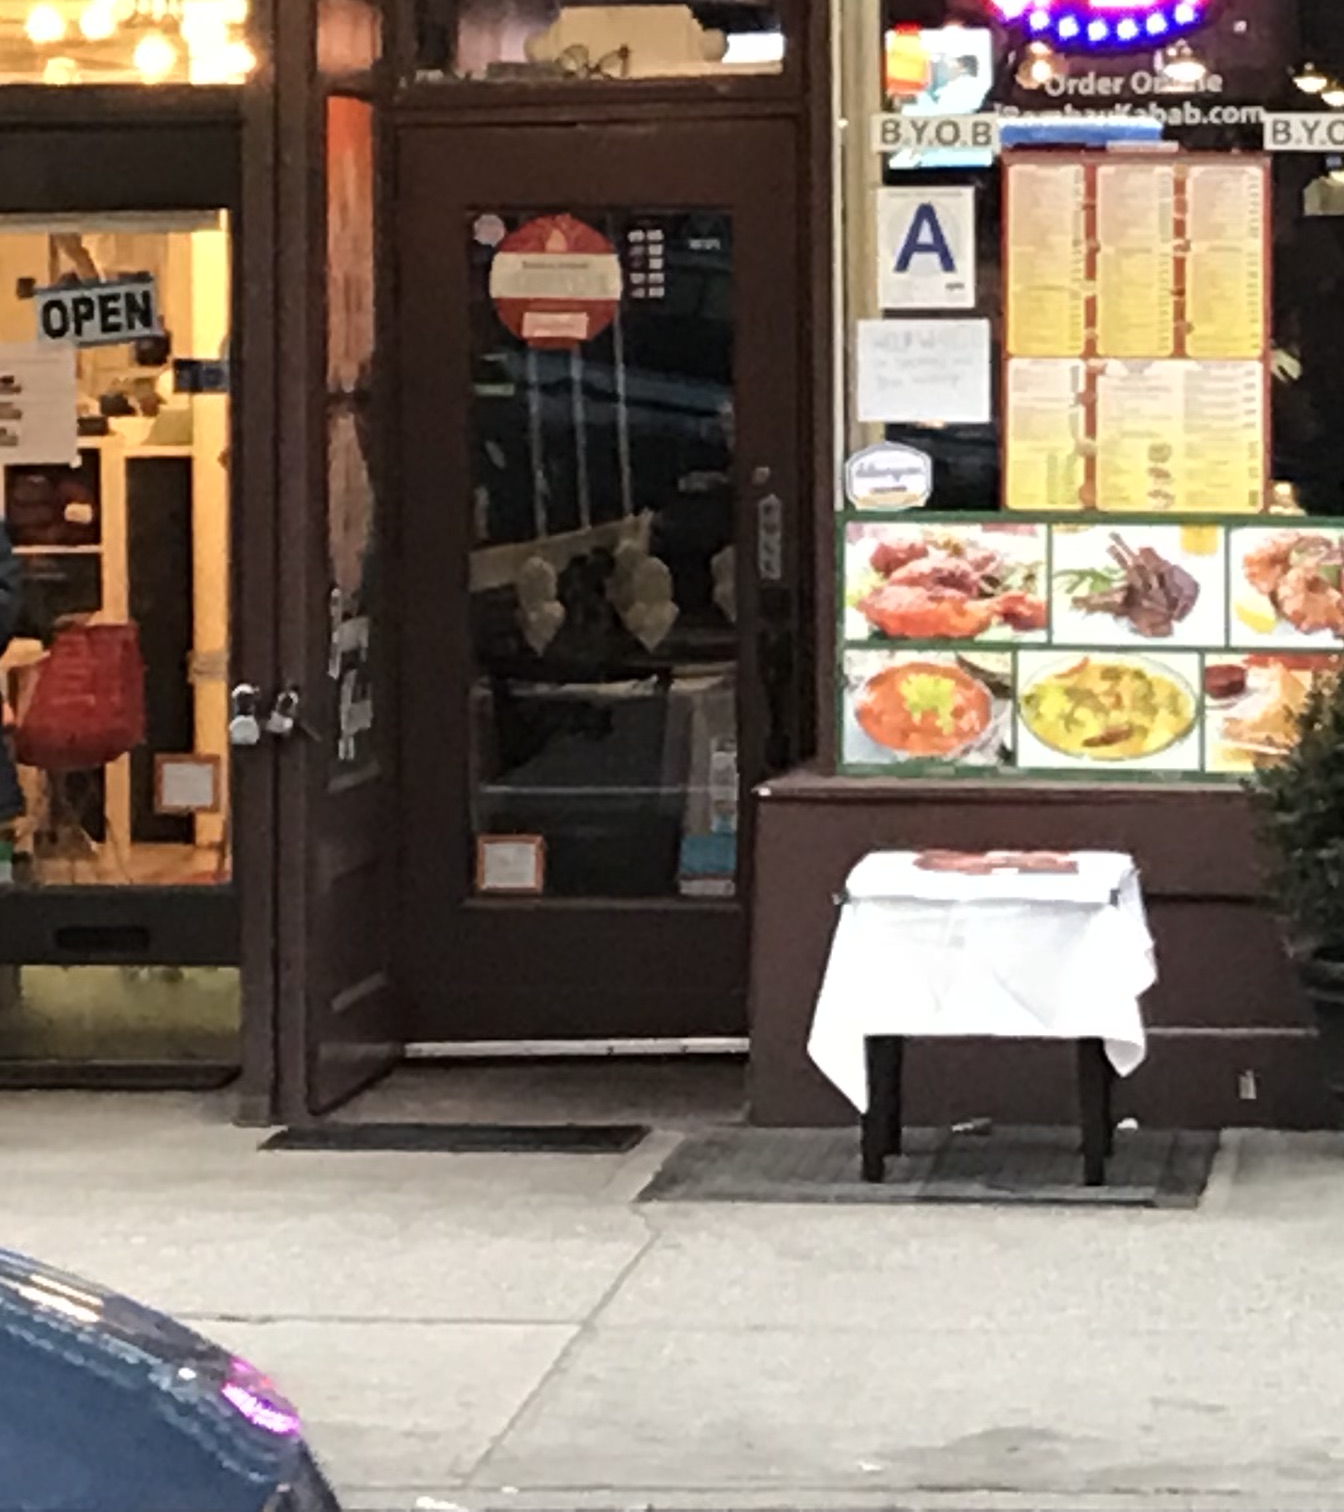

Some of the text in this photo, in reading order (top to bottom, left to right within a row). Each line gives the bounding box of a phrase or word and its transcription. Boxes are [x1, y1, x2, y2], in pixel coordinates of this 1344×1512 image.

[1045, 70, 1223, 96] Order Onne
[893, 202, 956, 273] A
[42, 290, 153, 339] OPEN
